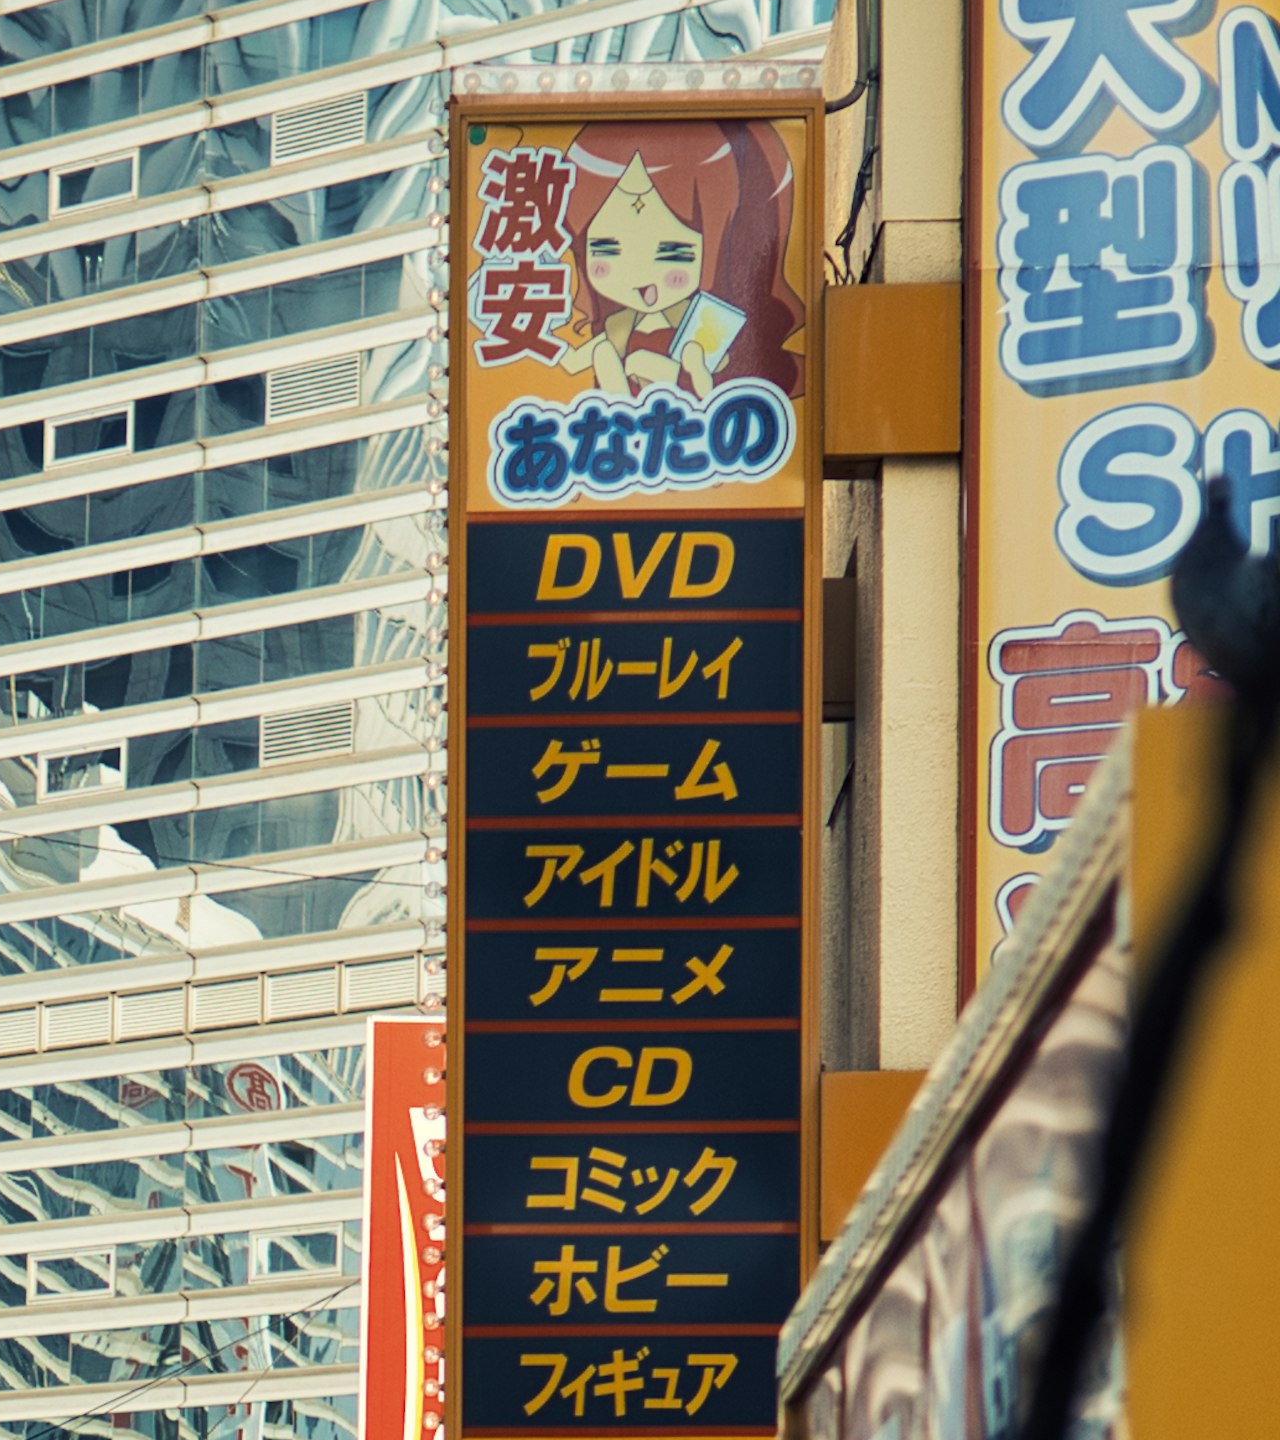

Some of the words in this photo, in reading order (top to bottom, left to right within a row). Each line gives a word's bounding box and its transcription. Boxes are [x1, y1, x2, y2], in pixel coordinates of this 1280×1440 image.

[479, 149, 573, 366] 激安
[504, 392, 781, 494] あなたの
[535, 532, 737, 602] DVD
[526, 636, 744, 702] ブルーレイ
[530, 738, 740, 804] ゲーム
[522, 839, 740, 910] アイドル
[528, 944, 735, 1007] アニメ
[566, 1046, 693, 1109] CD
[526, 1145, 738, 1217] コミック
[530, 1243, 729, 1316] ホビー
[518, 1346, 739, 1417] フィギュア
